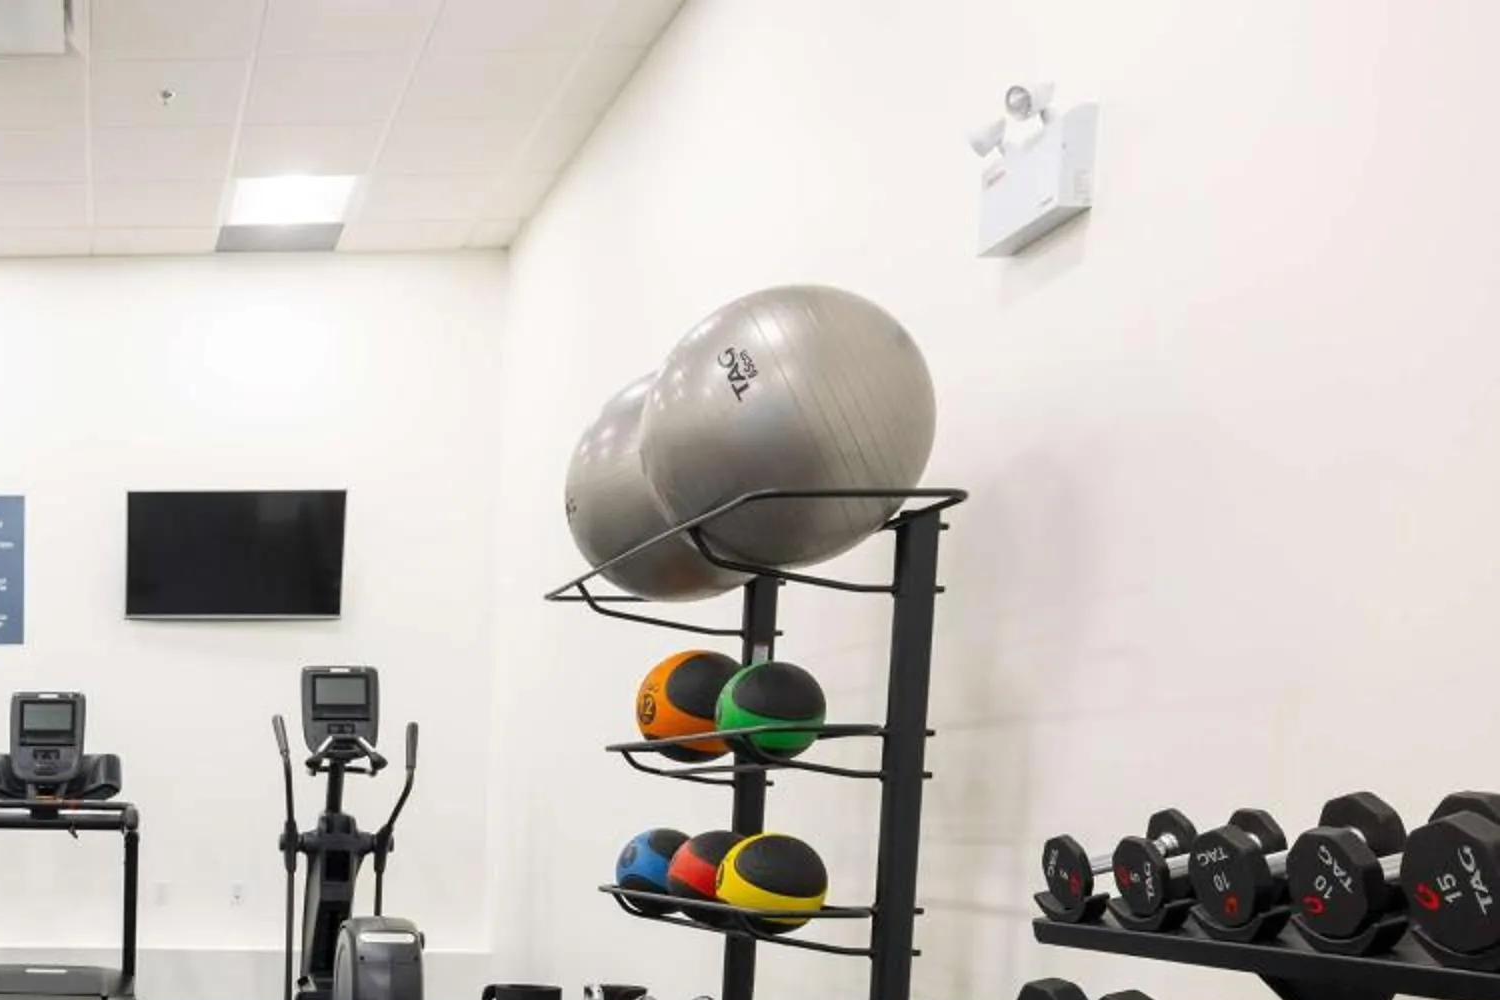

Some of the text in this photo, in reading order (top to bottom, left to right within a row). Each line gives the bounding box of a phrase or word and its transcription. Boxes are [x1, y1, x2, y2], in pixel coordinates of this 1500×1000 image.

[717, 346, 750, 402] TAG
[1196, 847, 1229, 867] TAG
[1318, 844, 1354, 894] TAG
[1213, 871, 1231, 893] 10
[1314, 875, 1333, 899] 10
[1436, 873, 1463, 904] 15
[1457, 844, 1493, 916] TAG
